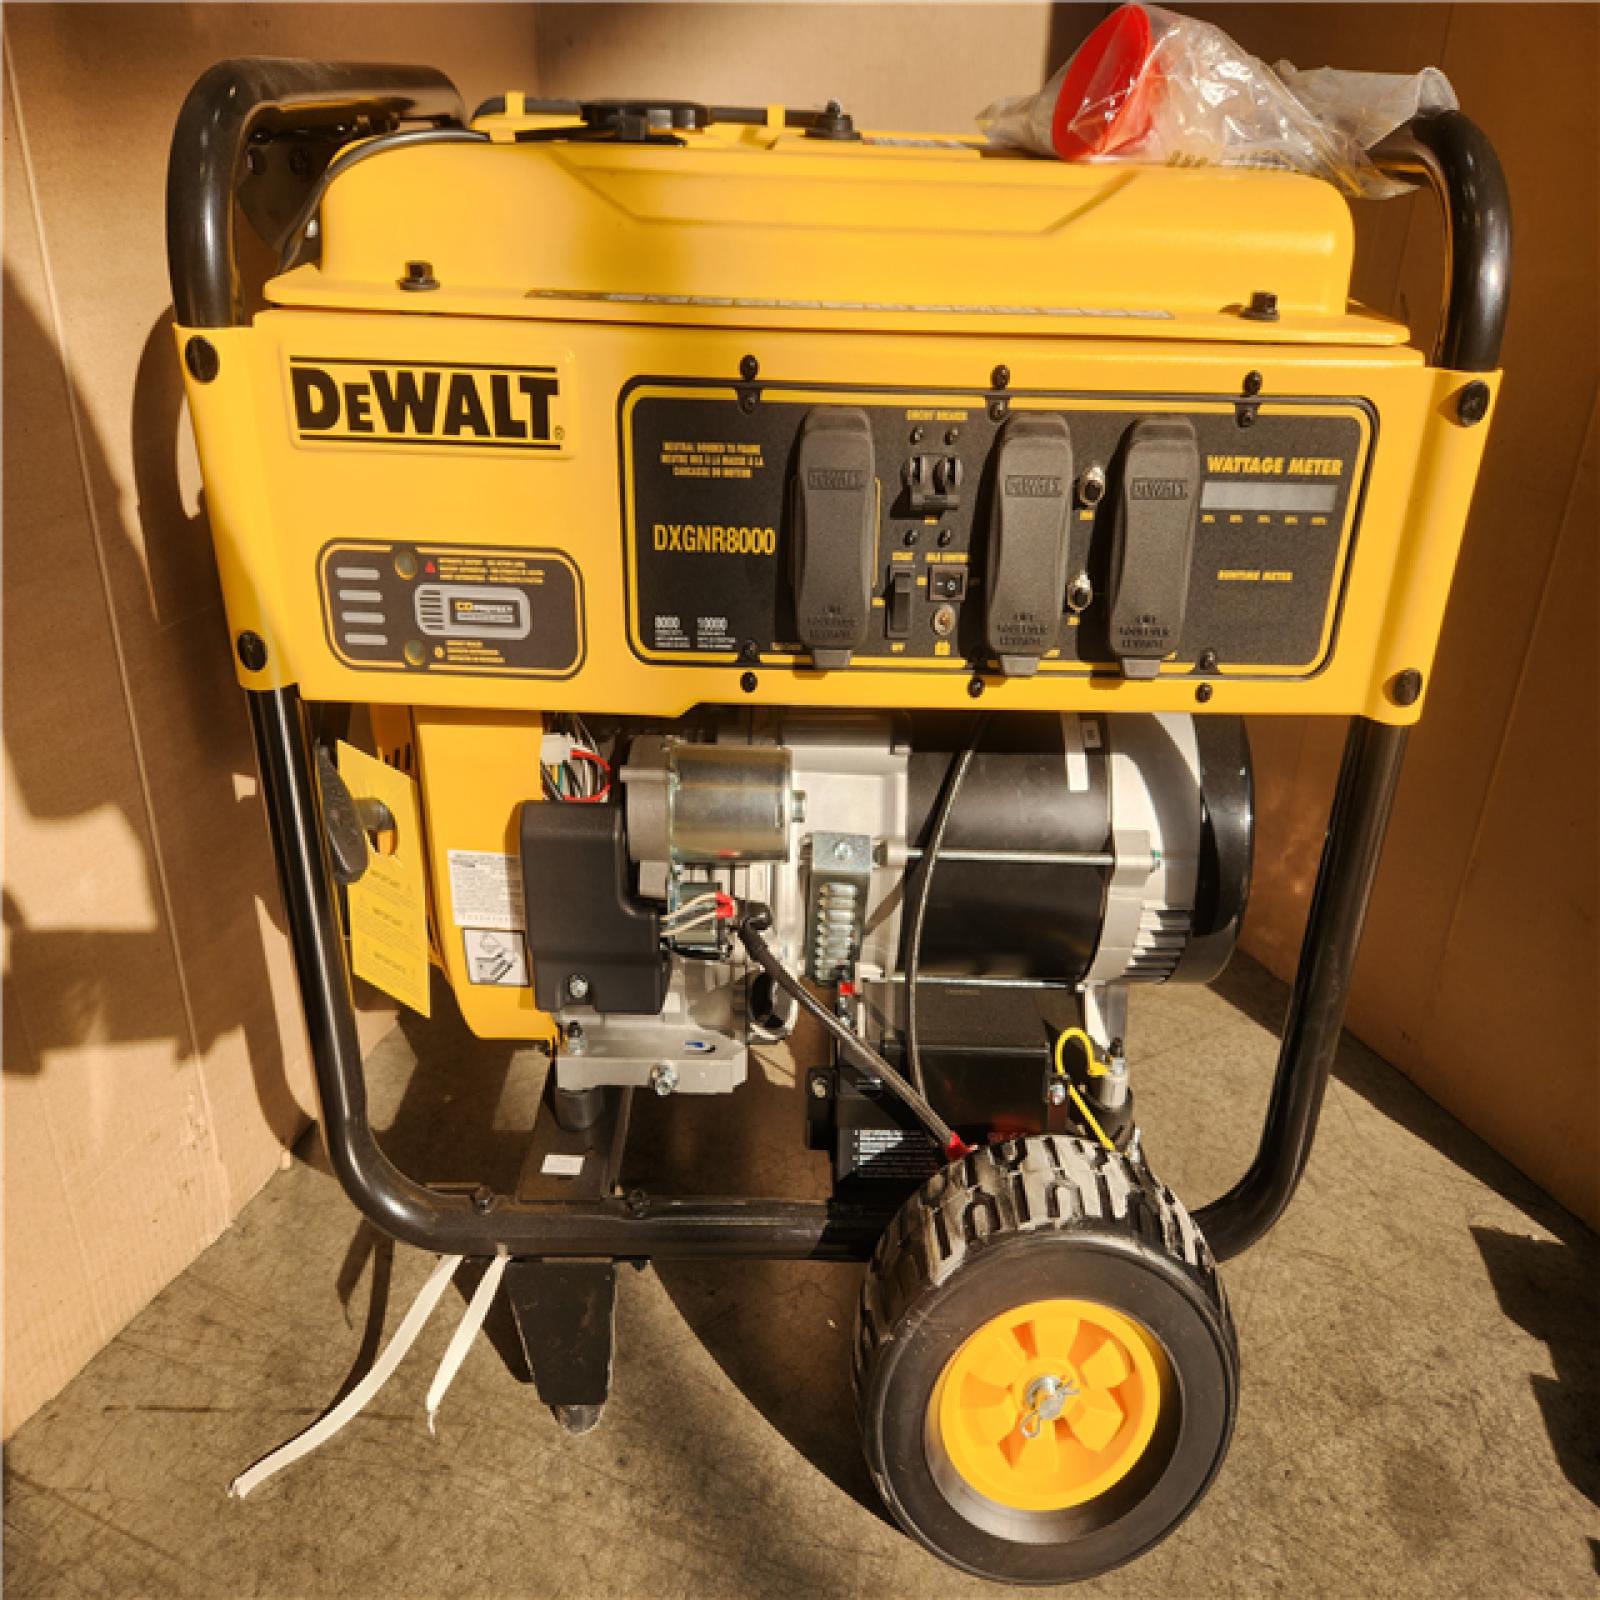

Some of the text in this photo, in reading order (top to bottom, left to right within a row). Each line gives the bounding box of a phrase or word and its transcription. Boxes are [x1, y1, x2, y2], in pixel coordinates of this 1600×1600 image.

[1207, 455, 1343, 476] WATTAGE METER
[653, 523, 776, 555] DXGNR8000
